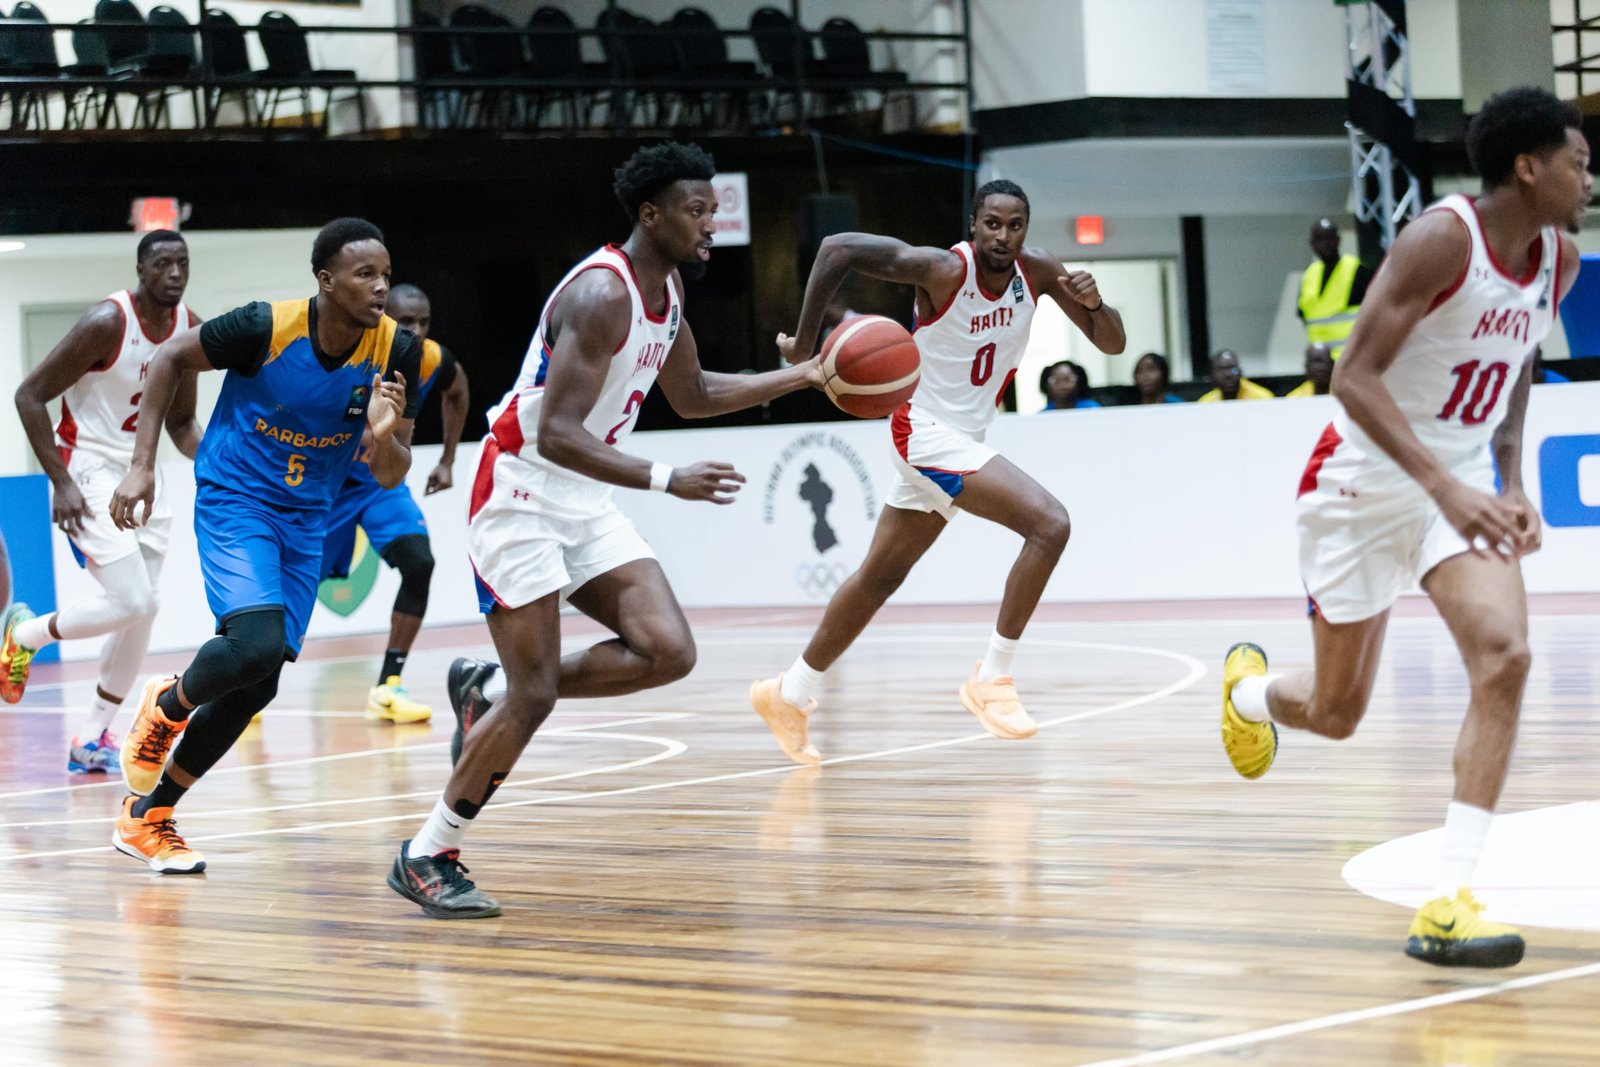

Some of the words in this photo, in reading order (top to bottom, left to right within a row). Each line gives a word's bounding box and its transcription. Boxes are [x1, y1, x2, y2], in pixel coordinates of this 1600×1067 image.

[970, 307, 1013, 334] HAITI
[970, 342, 996, 386] 0
[1436, 359, 1510, 425] 10
[255, 418, 352, 448] BARBADOS
[604, 389, 645, 445] 2
[284, 453, 307, 487] 5
